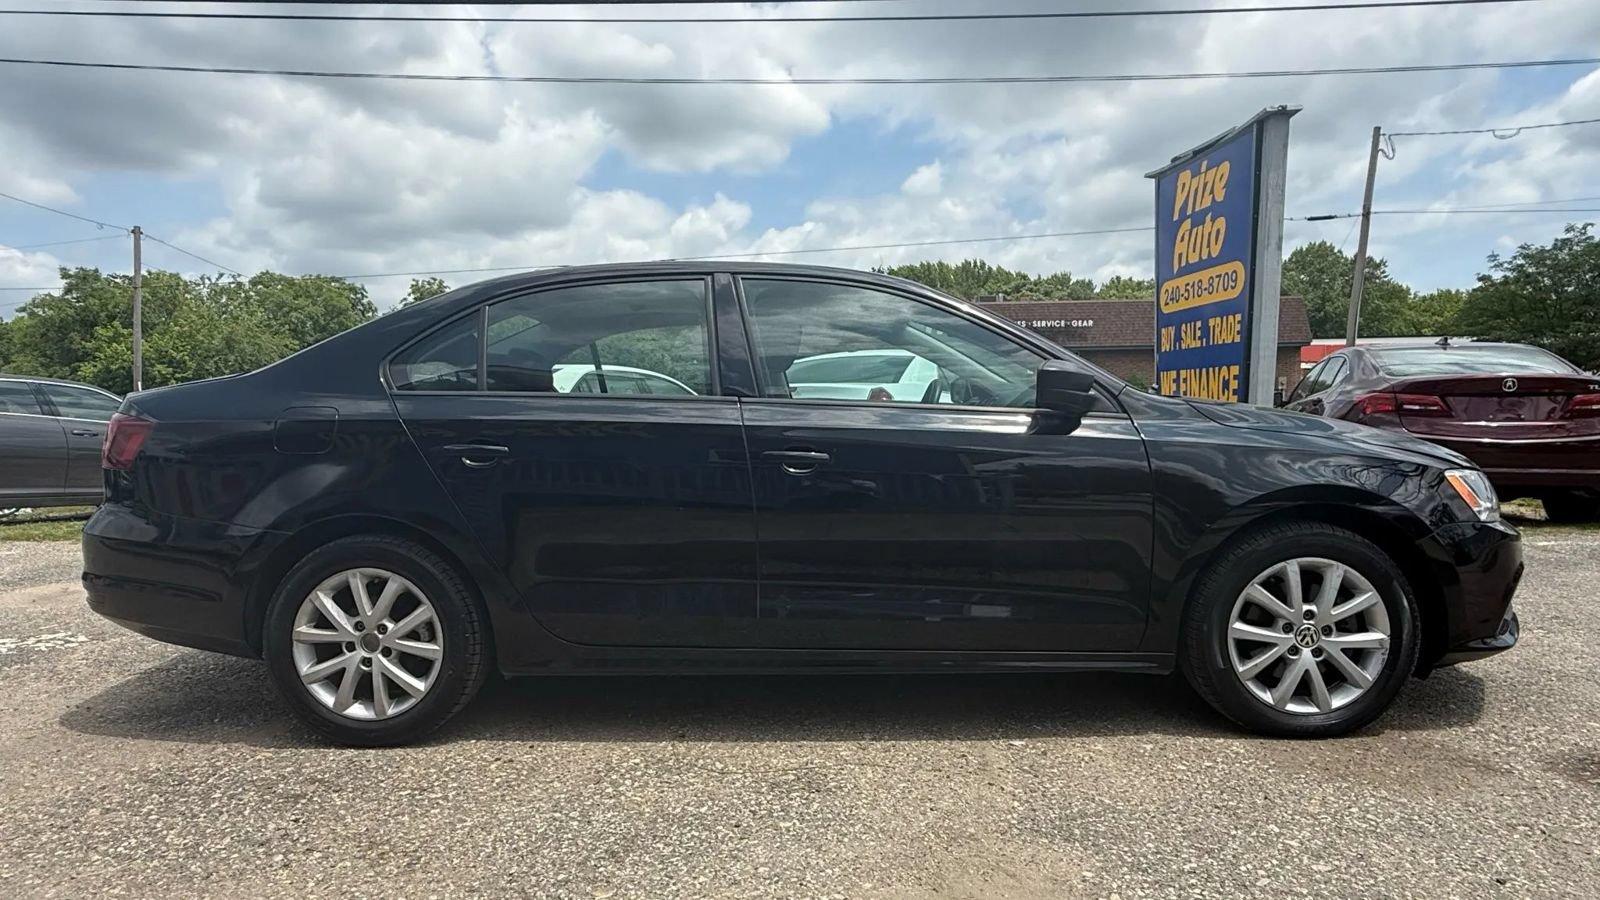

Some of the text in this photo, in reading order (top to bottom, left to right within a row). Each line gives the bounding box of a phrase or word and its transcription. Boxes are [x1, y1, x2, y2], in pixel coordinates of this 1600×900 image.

[1173, 160, 1230, 221] Prize
[1173, 211, 1226, 275] Auto
[1164, 270, 1238, 306] 240-518-8709
[1032, 320, 1065, 328] SERVICE
[1071, 320, 1093, 328] GEAR
[1161, 314, 1241, 352] BUY SALE TRADE
[1180, 365, 1239, 402] FINANCE
